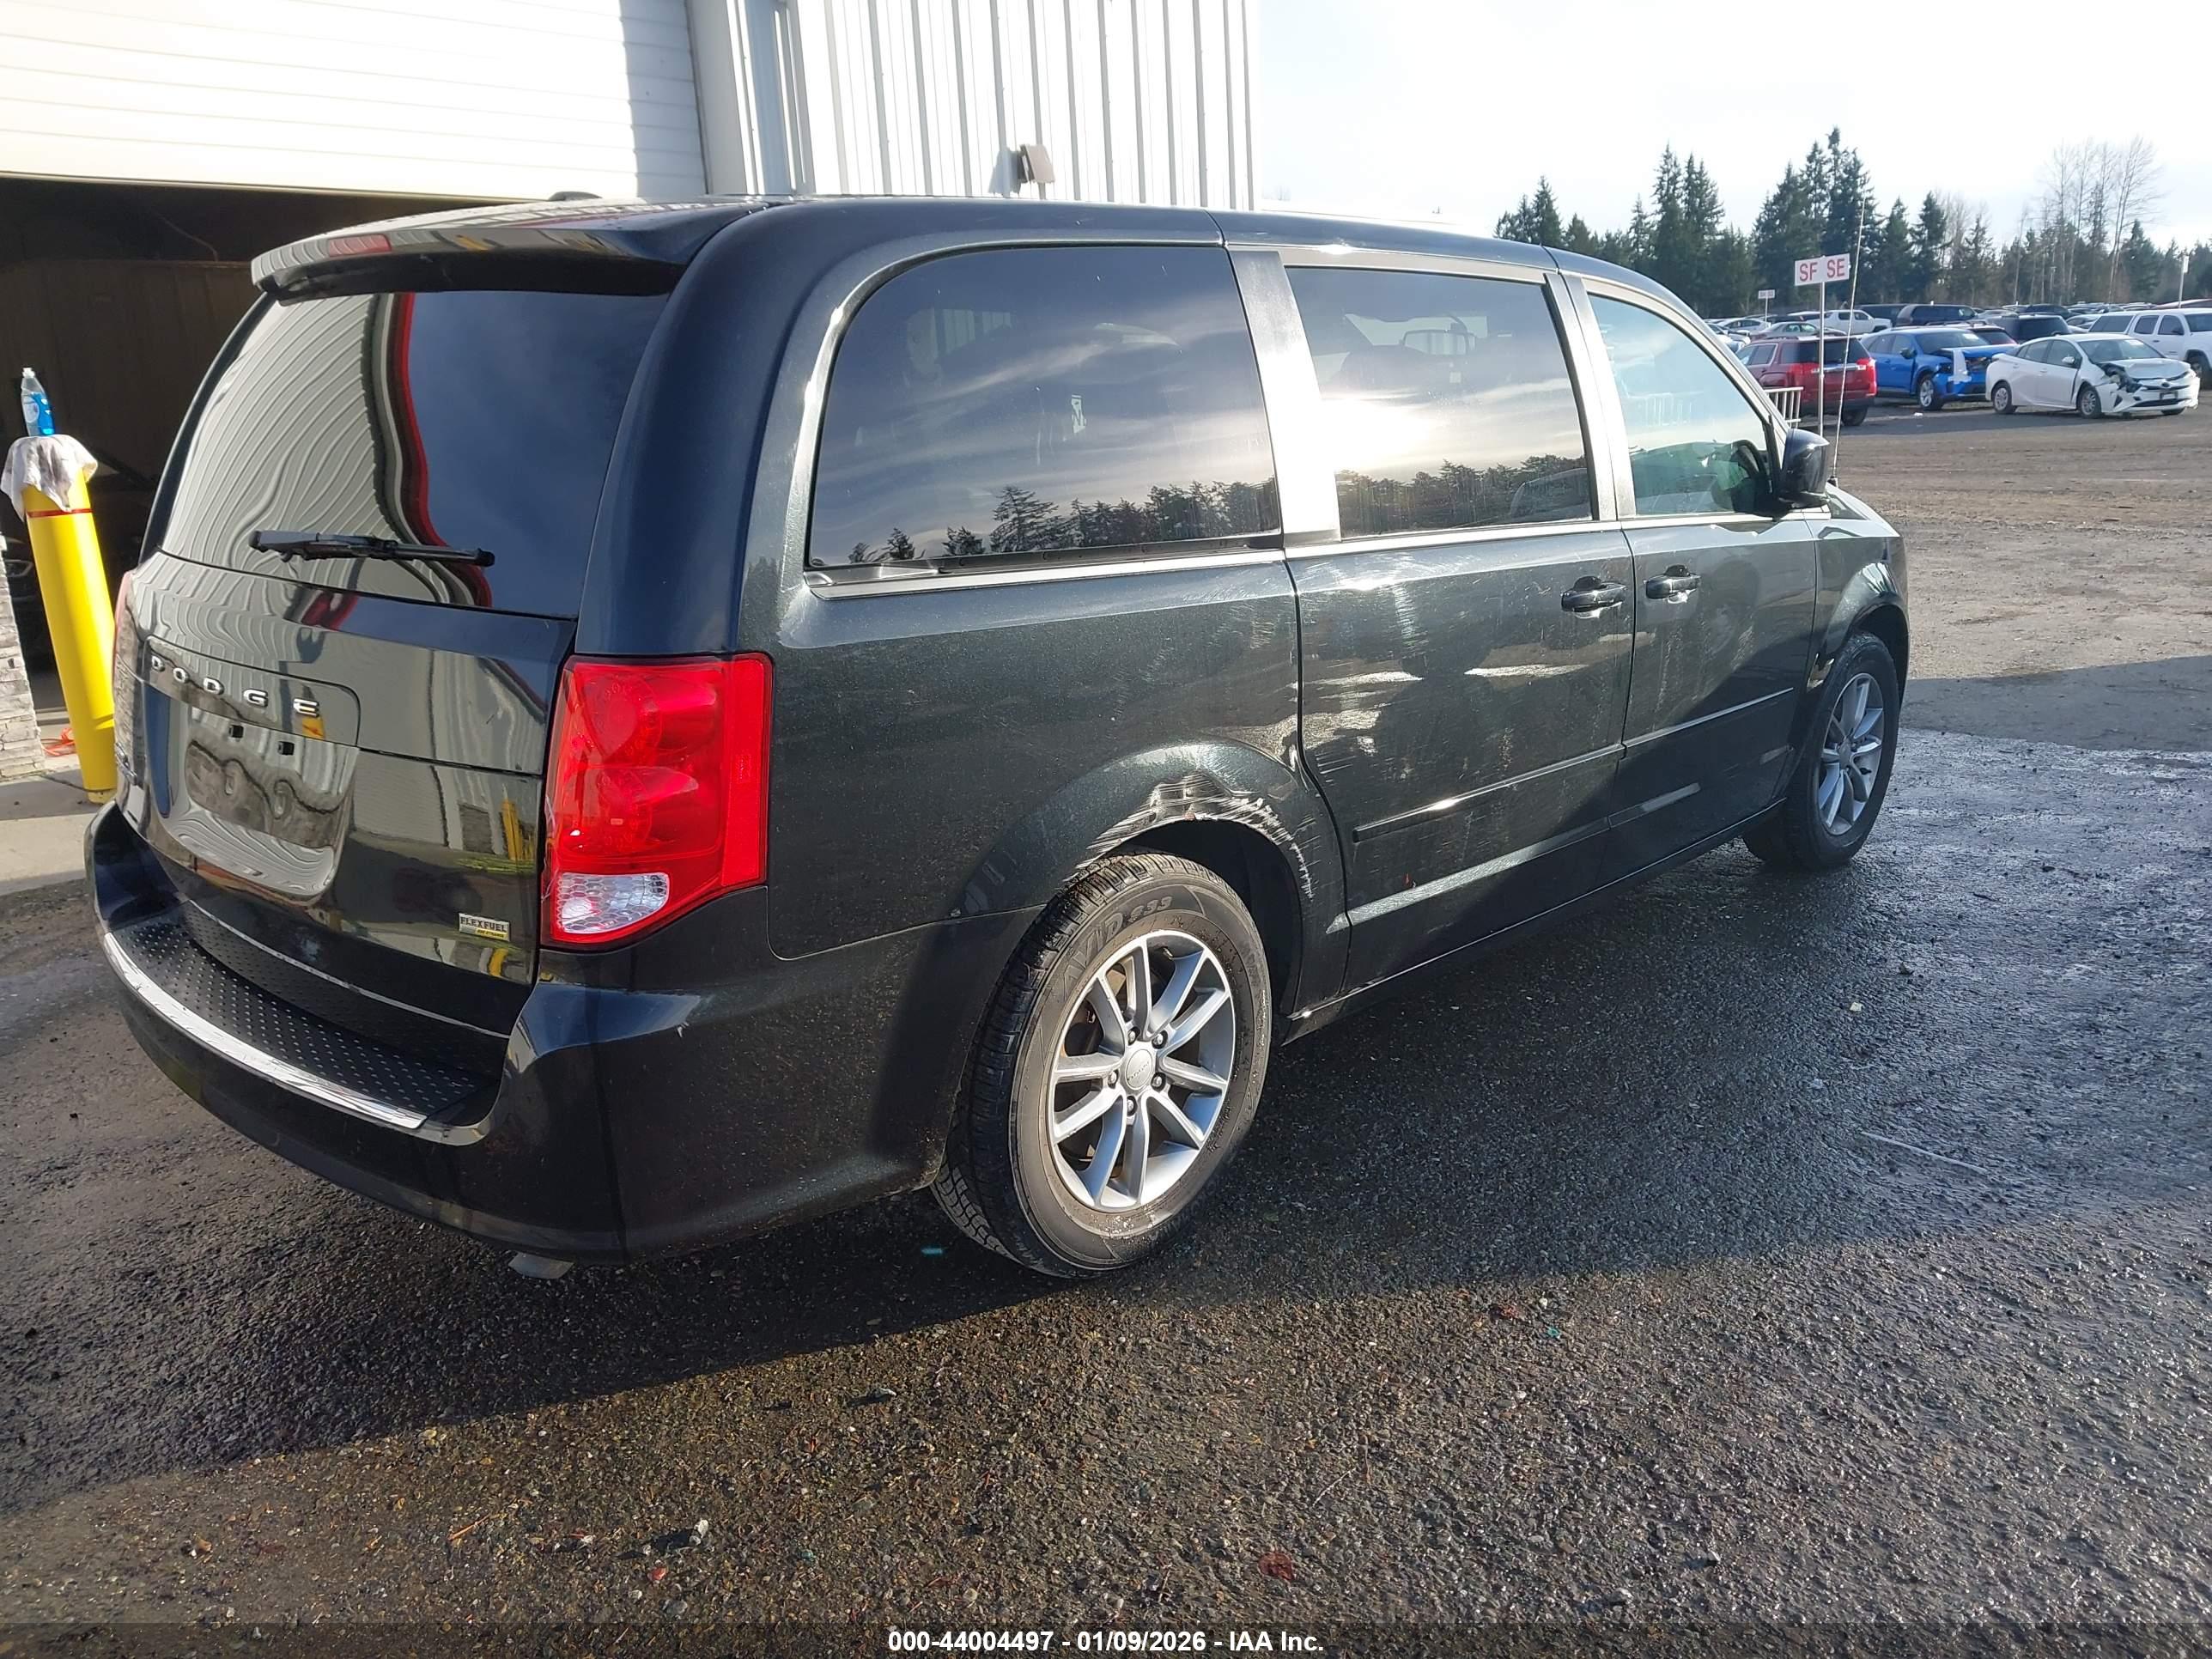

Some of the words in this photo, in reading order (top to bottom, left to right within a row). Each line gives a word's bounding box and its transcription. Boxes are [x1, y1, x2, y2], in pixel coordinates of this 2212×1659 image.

[1799, 262, 1818, 282] SF
[1826, 258, 1845, 278] SE
[151, 655, 321, 718] DODGE
